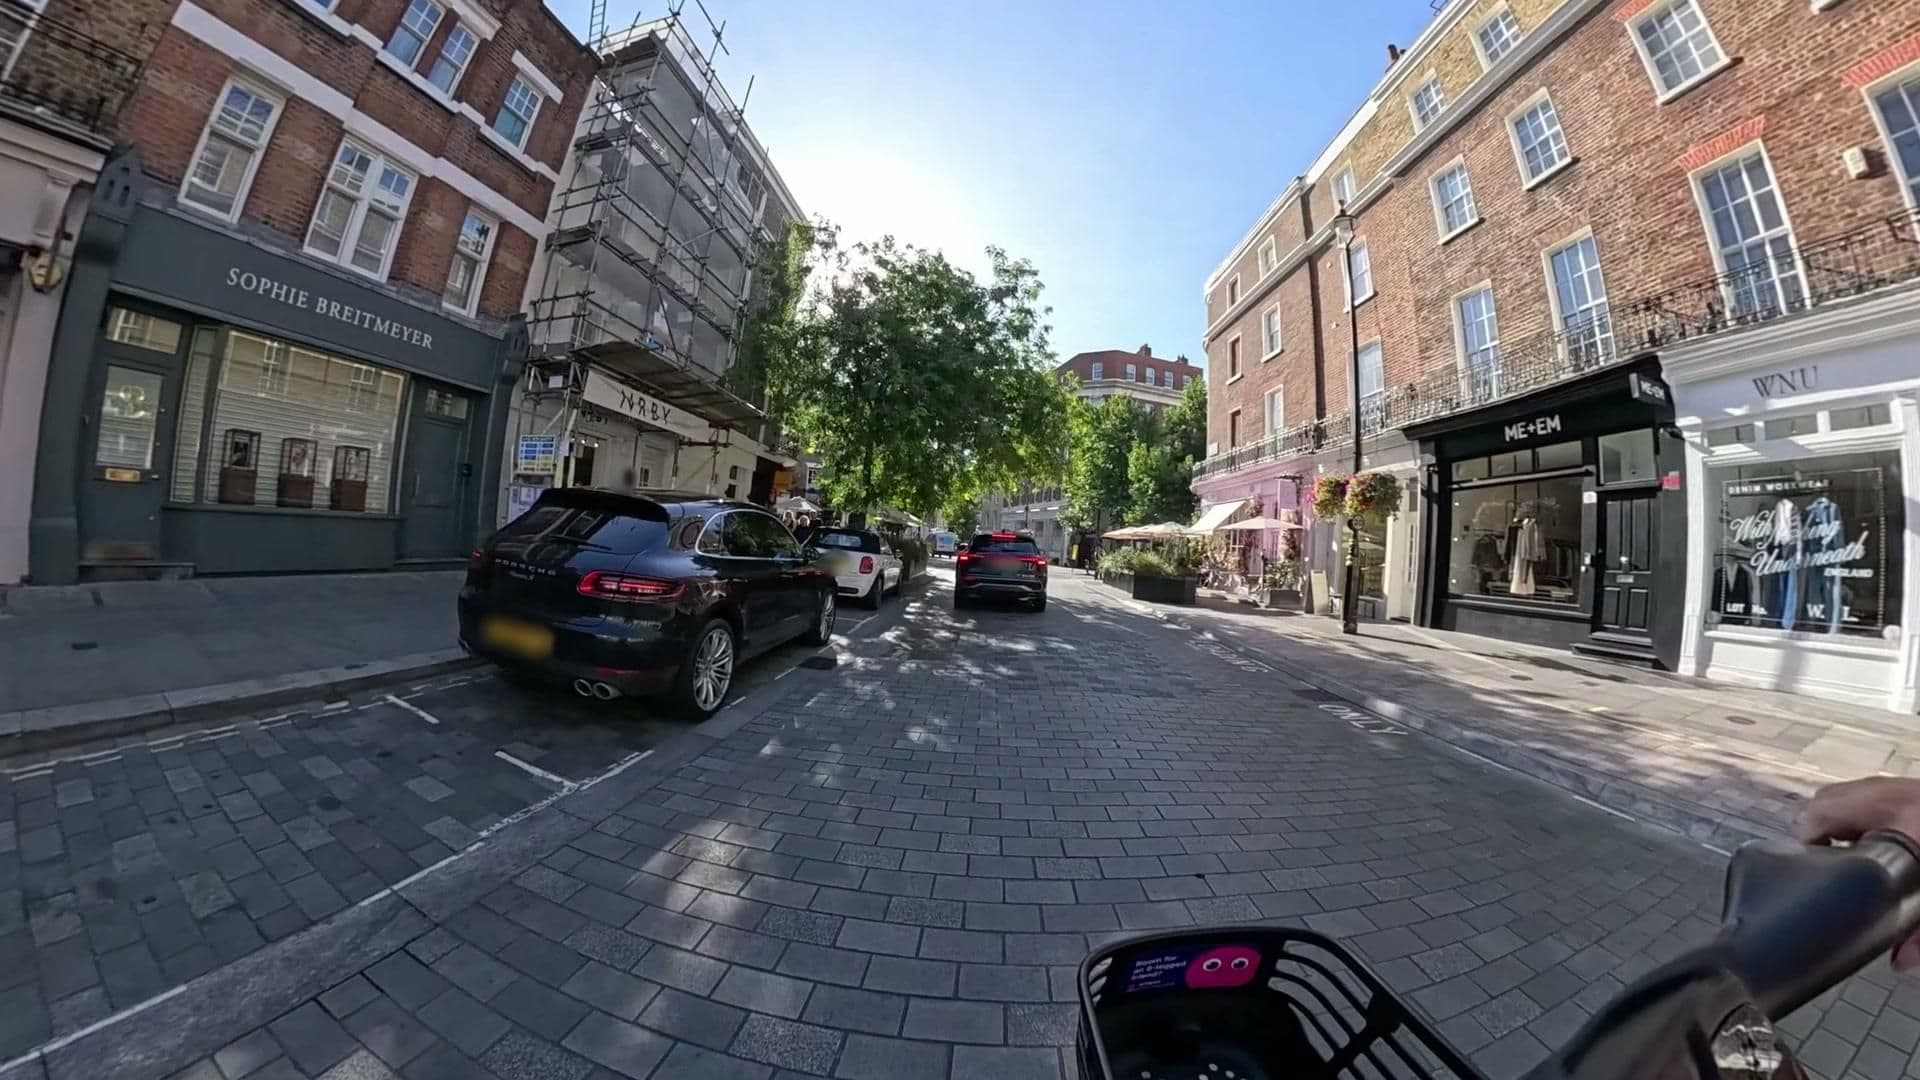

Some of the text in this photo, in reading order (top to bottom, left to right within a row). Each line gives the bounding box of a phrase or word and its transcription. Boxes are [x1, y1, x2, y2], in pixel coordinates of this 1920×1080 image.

[226, 267, 434, 350] SOPHIE BREITMEYER
[1752, 365, 1819, 398] WNU
[619, 389, 671, 424] NRBY
[1504, 414, 1561, 442] ME+EM
[1728, 485, 1761, 494] DENIM
[495, 558, 557, 577] PORSCHE
[1726, 602, 1745, 613] LOT
[1318, 704, 1409, 736] ONLY
